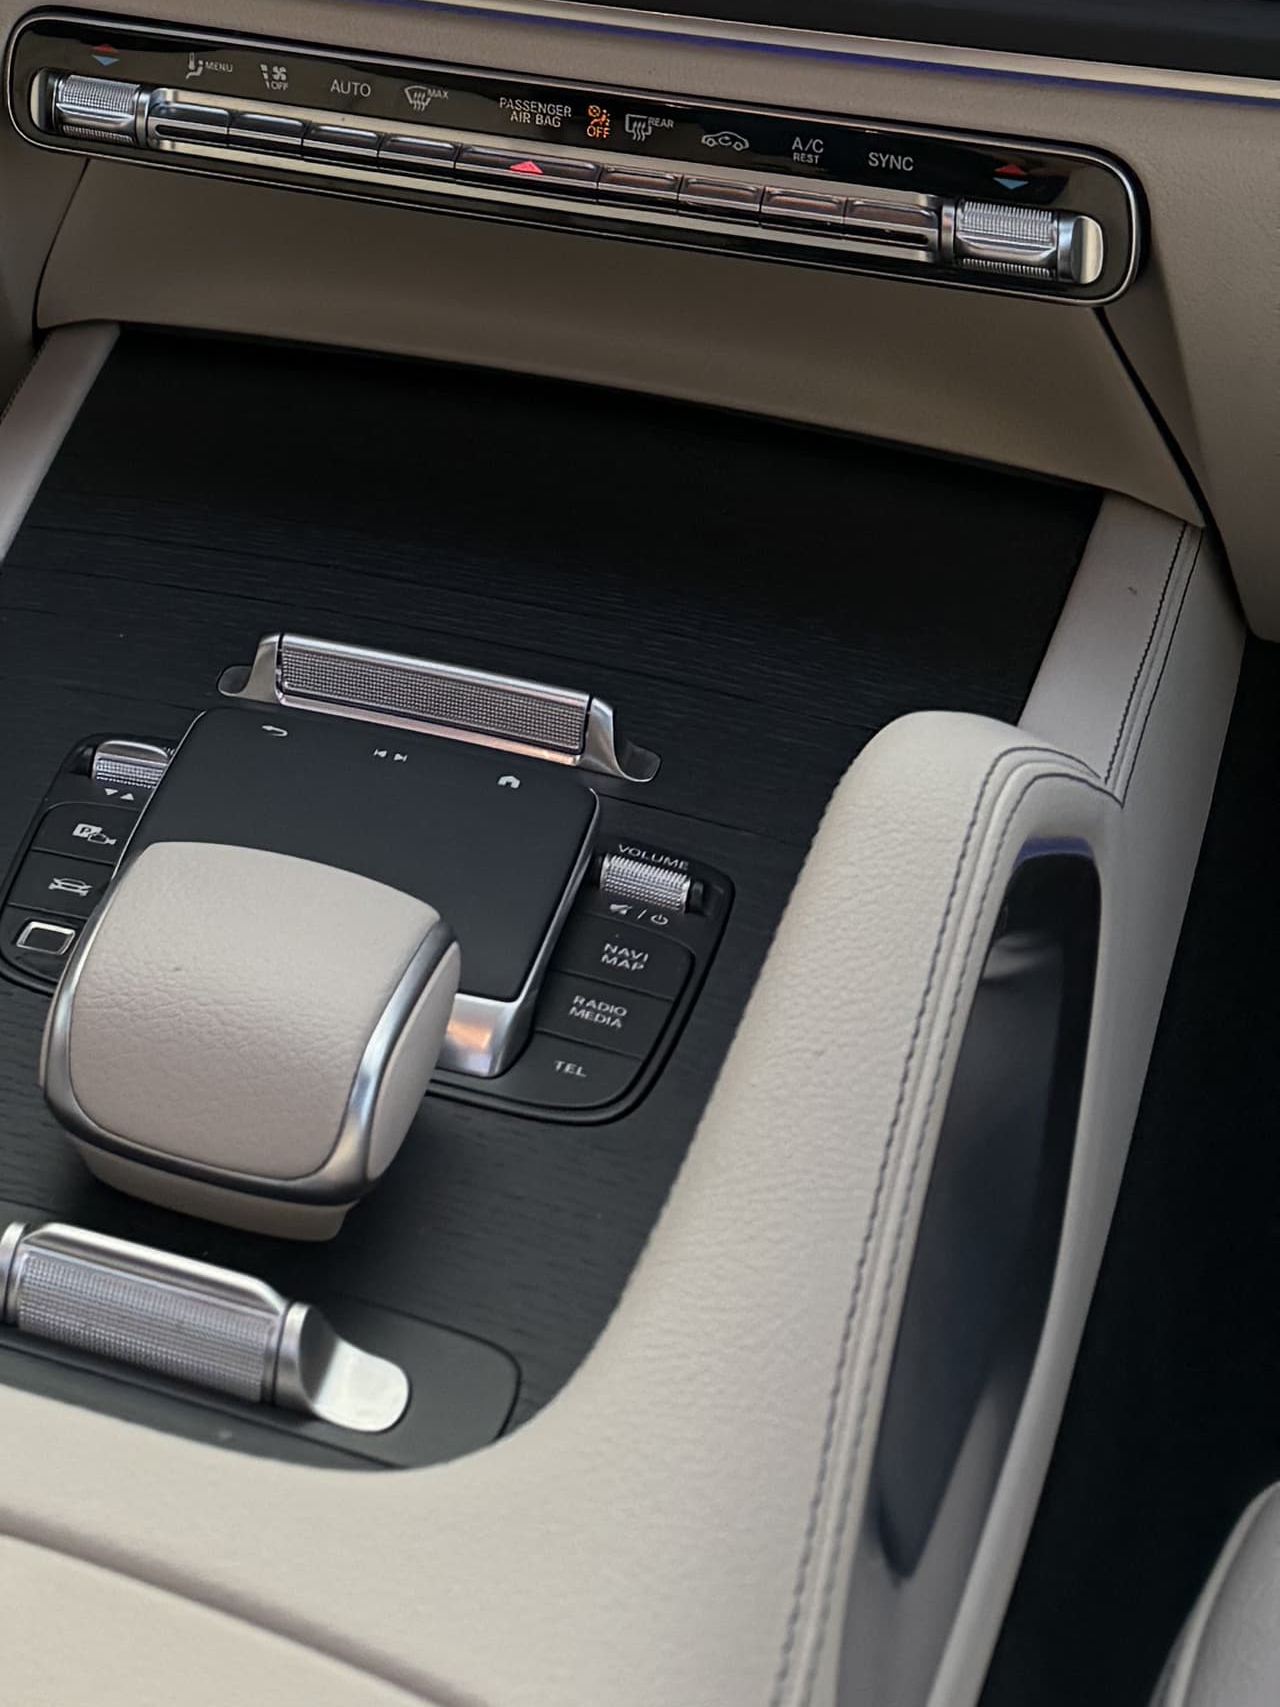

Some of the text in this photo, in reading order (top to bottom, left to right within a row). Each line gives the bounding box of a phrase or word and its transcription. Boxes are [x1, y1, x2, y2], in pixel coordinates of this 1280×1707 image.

[204, 61, 233, 73] MENU
[330, 79, 371, 97] AUTO
[427, 88, 449, 100] MAX
[499, 97, 572, 118] PASSENGER
[510, 110, 561, 128] AIR BAG
[648, 117, 675, 129] REAR
[586, 125, 610, 138] OFF
[792, 136, 824, 154] A/C
[793, 152, 820, 164] REST
[868, 151, 914, 171] SYNC
[618, 843, 689, 871] VOLUME
[604, 943, 649, 962] NAVI
[601, 954, 645, 971] MAP
[573, 995, 628, 1017] RADIO
[569, 1006, 622, 1028] MEDIA
[554, 1060, 588, 1078] TEL
